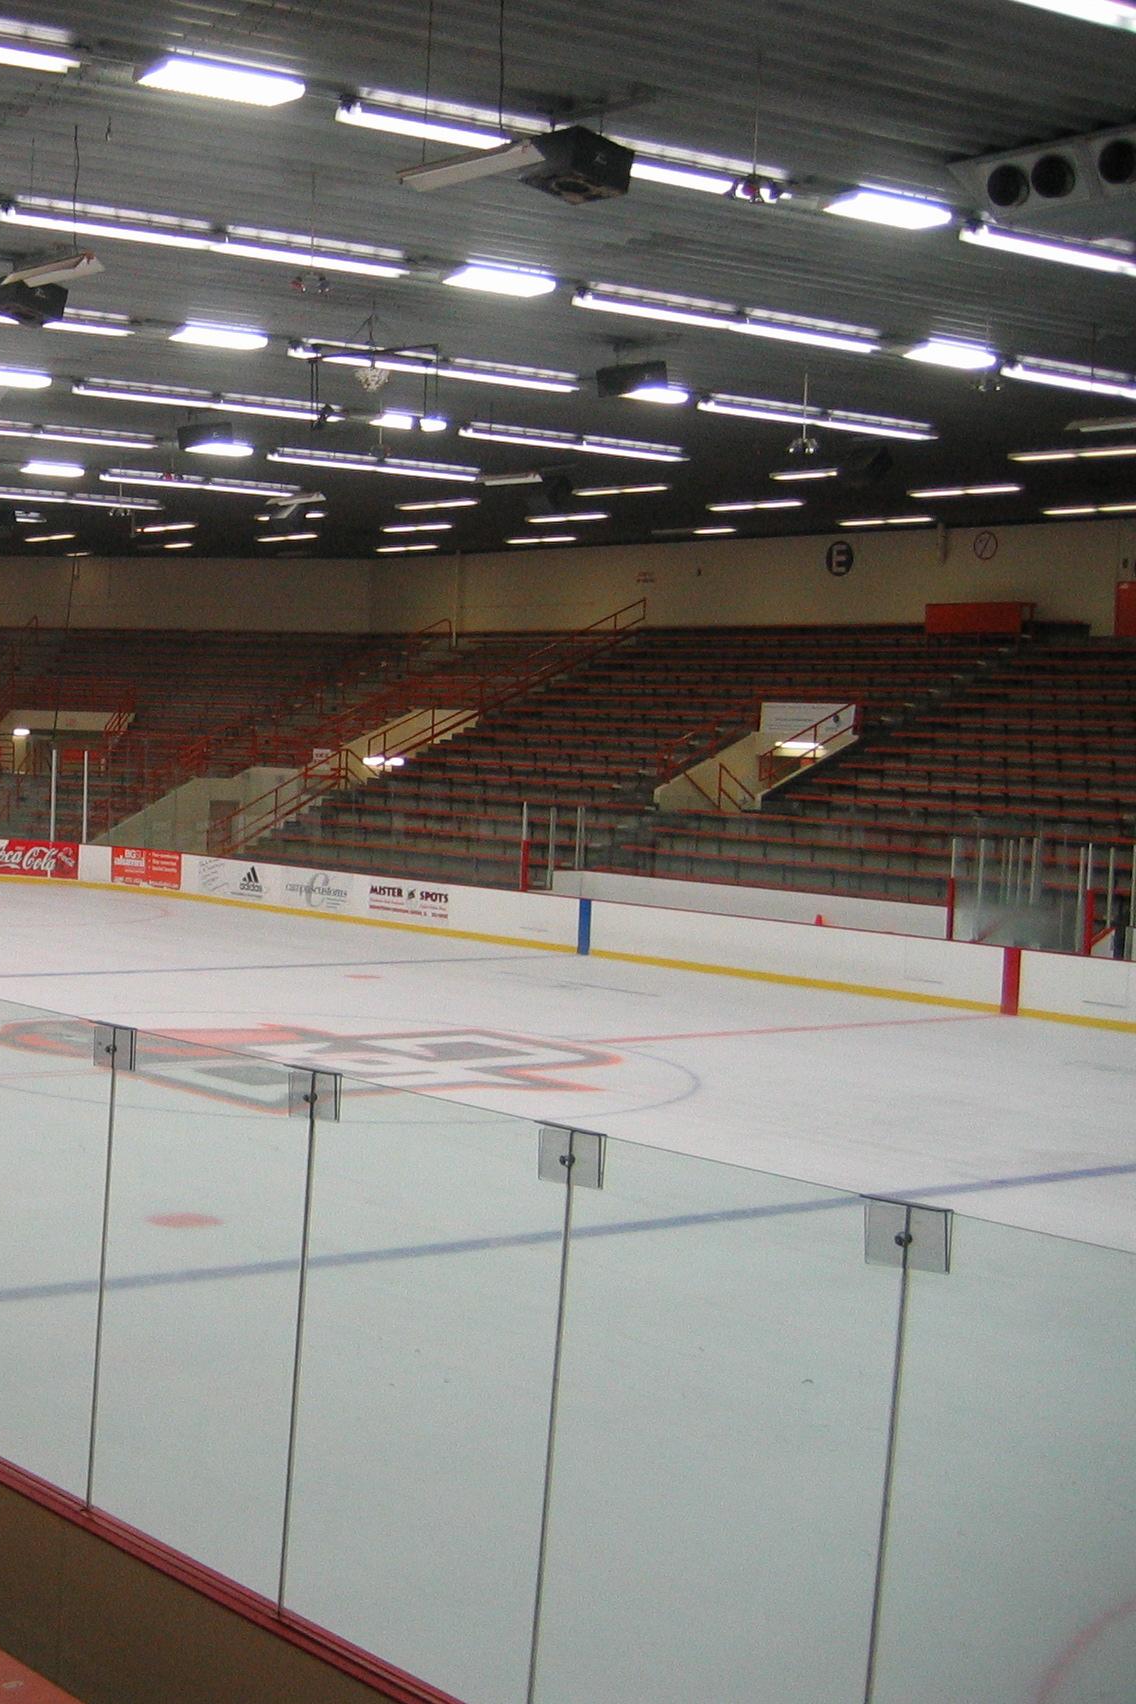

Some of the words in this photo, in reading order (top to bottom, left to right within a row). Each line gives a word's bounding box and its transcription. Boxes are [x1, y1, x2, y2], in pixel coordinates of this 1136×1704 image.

[831, 545, 848, 573] E
[369, 885, 404, 898] MISTER
[419, 890, 449, 904] SPOTS
